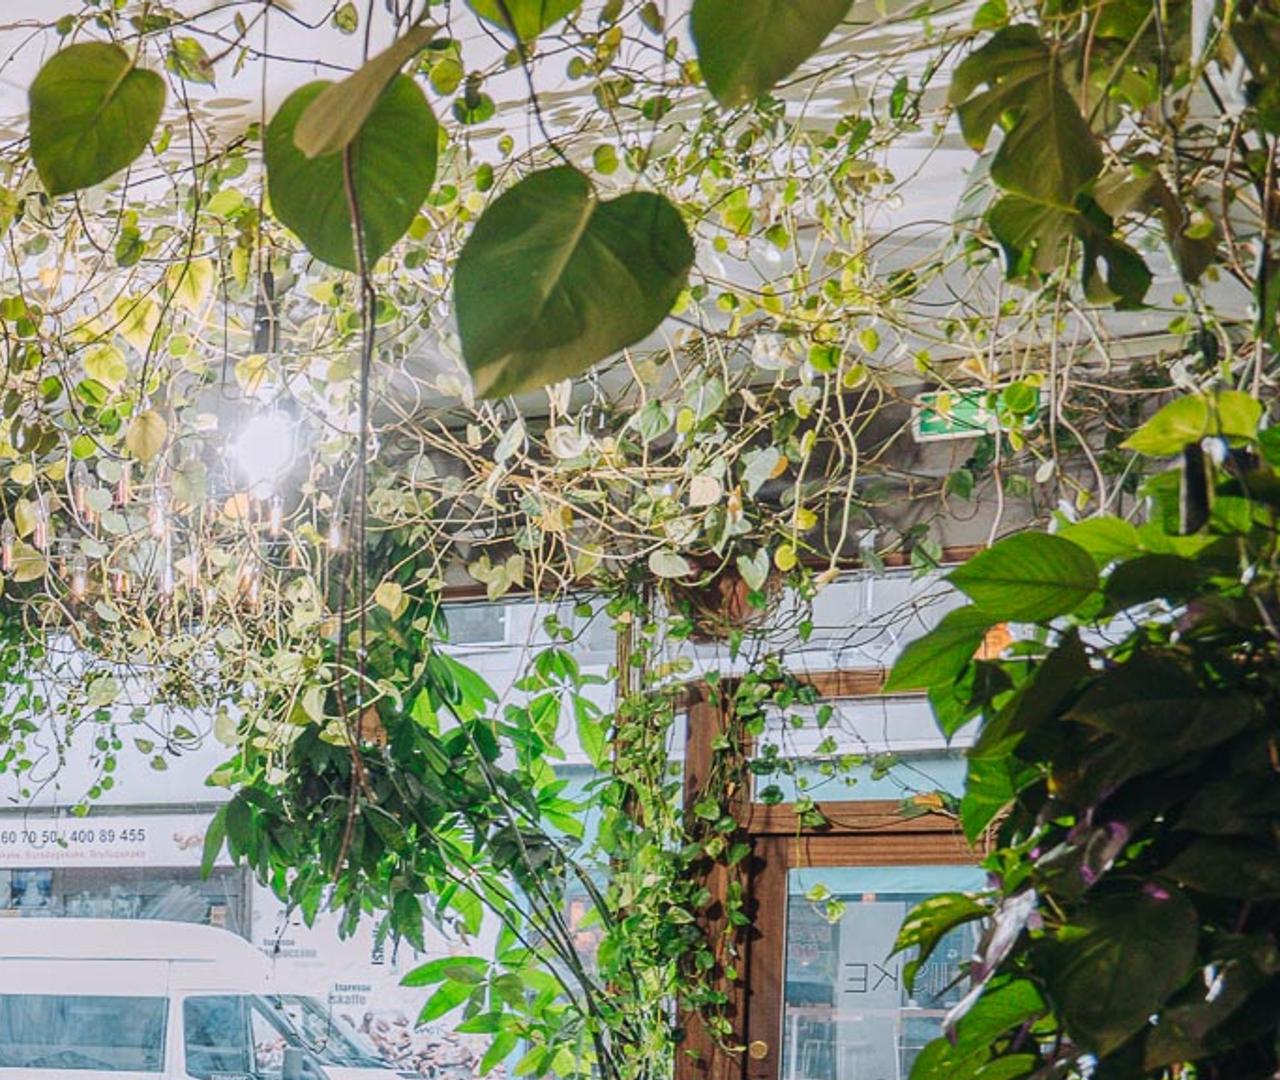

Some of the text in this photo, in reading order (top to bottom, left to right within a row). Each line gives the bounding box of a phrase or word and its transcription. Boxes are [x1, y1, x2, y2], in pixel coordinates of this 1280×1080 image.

[1, 831, 17, 844] 60
[21, 830, 37, 844] 70
[42, 830, 57, 844] 50
[70, 829, 95, 844] 400
[98, 829, 116, 843] 89
[119, 828, 147, 843] 455
